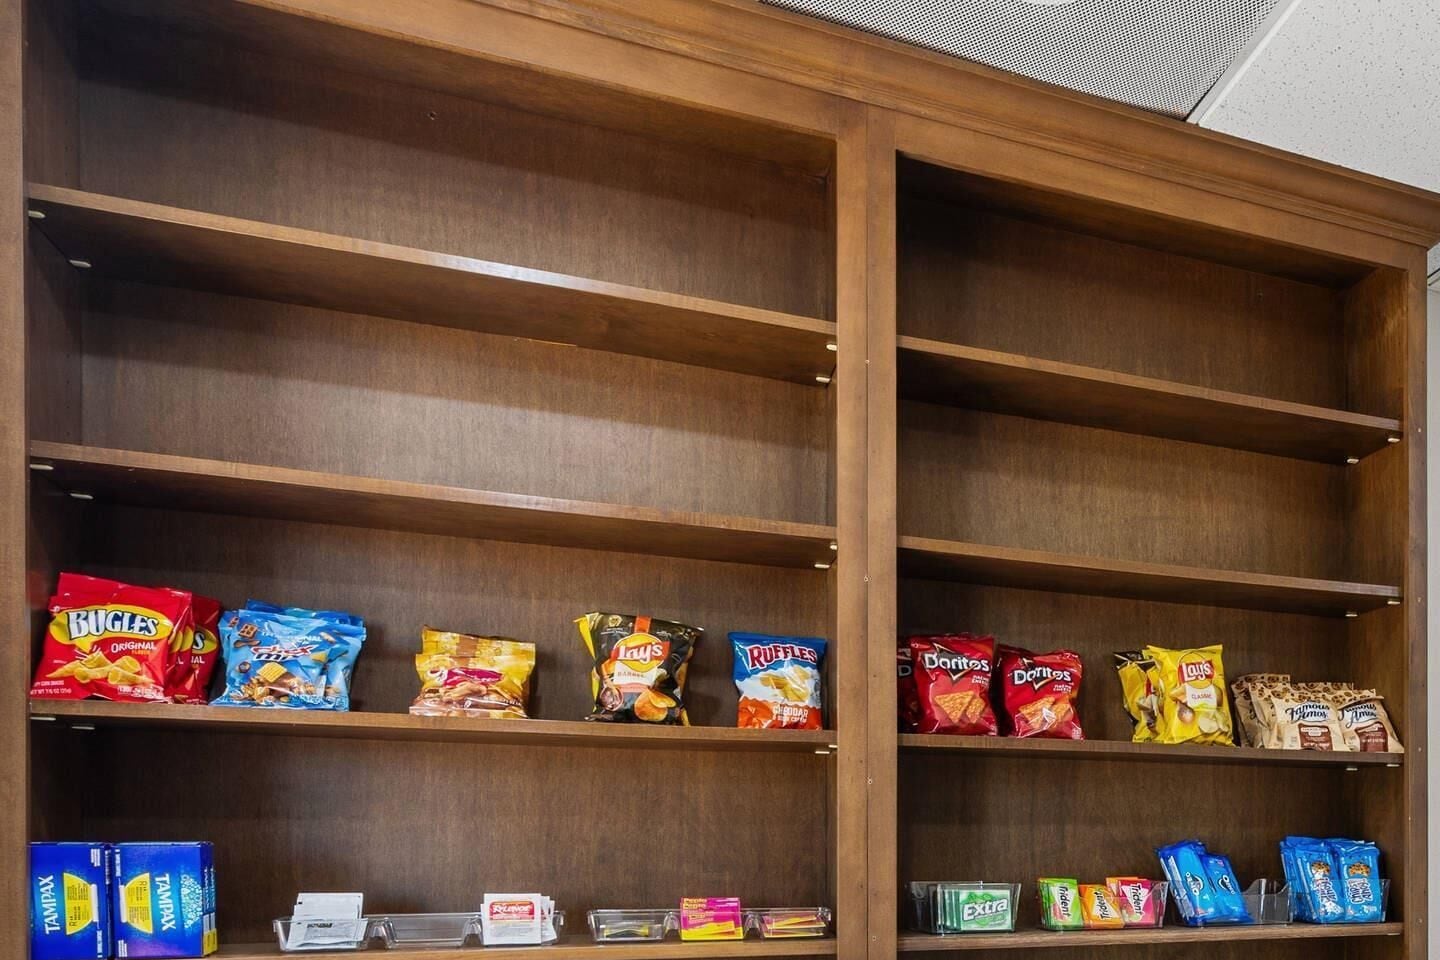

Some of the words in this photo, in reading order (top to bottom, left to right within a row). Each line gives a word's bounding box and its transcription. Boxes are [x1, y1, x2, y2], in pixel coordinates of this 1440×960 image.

[68, 609, 159, 640] BUGLES
[111, 642, 157, 654] ORIGINAL
[617, 642, 665, 665] Lay's
[748, 644, 818, 669] RUFFLES
[924, 652, 991, 673] Doritos
[1182, 660, 1211, 682] Lay's
[1014, 667, 1072, 686] Doritos
[38, 875, 61, 935] TAMPAX
[155, 874, 176, 931] TAMPAX
[963, 898, 1008, 921] Extra
[1059, 886, 1071, 917] Trident
[1130, 884, 1143, 915] Trident
